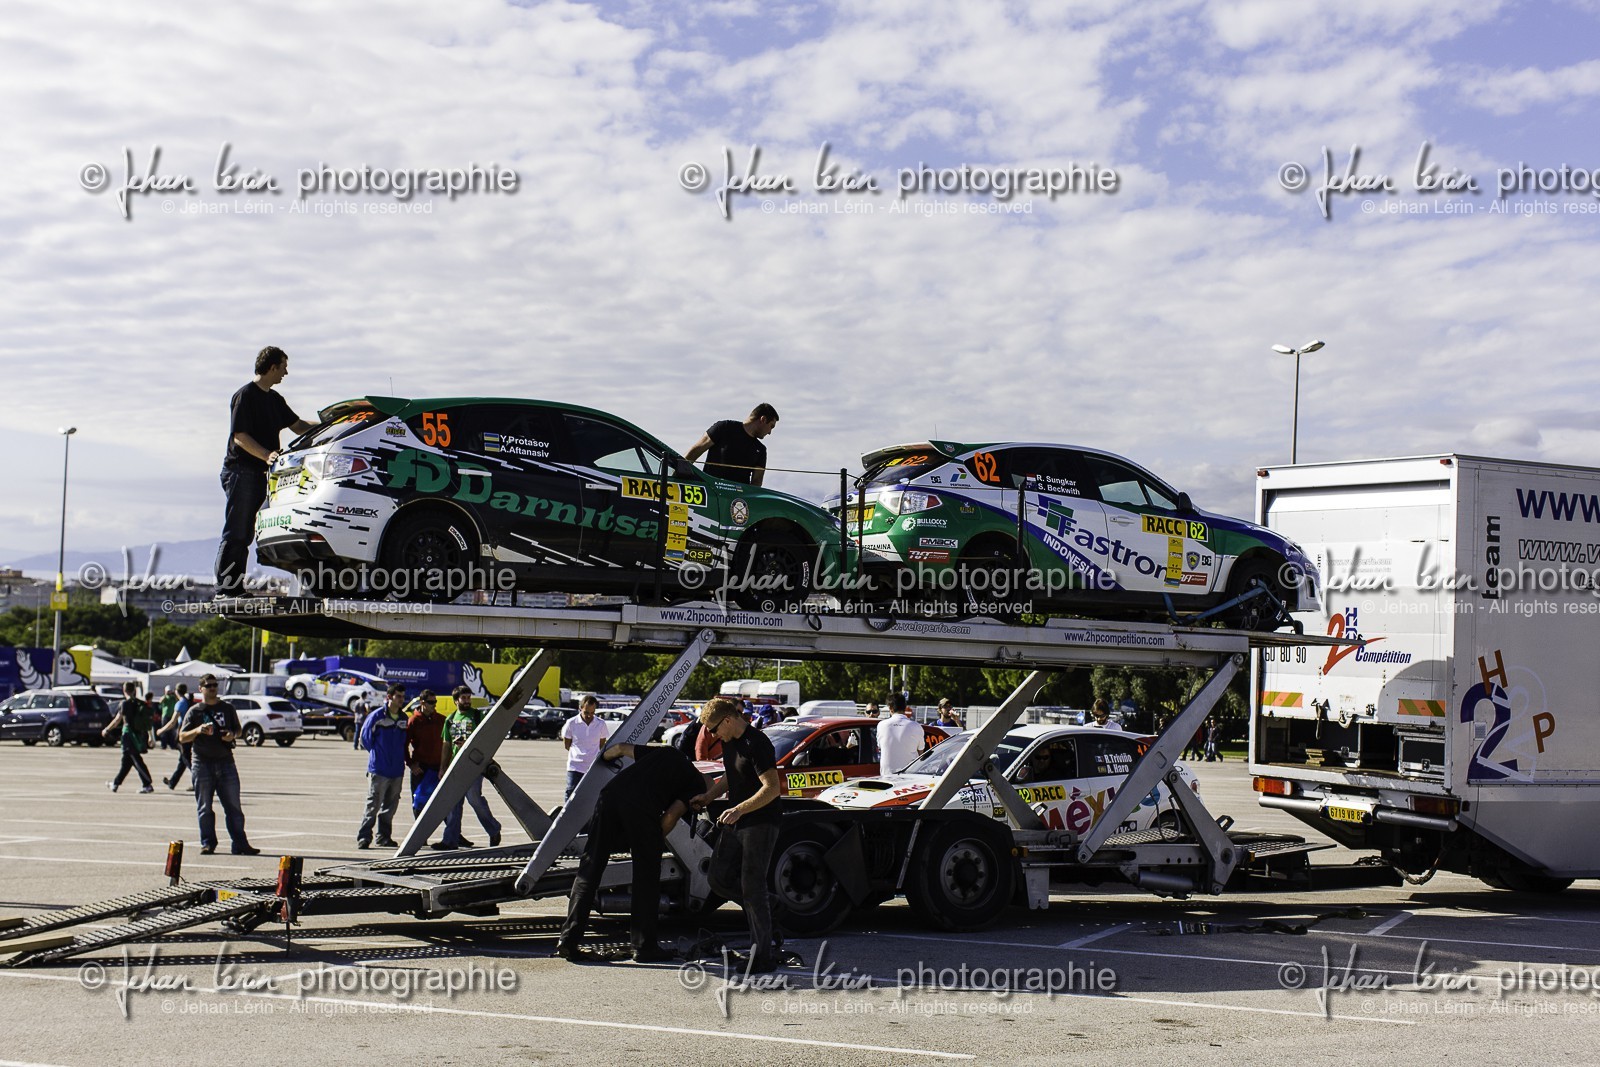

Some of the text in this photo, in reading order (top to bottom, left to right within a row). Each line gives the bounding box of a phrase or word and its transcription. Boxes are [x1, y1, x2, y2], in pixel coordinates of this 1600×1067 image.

[422, 412, 451, 448] 55
[500, 434, 550, 448] Y.Protasov
[500, 445, 550, 458] A.Aftanasiv
[900, 455, 929, 467] 62
[974, 451, 1000, 482] 62
[1036, 474, 1076, 487] R. Sungkar
[1038, 482, 1081, 495] S. Beckwith
[452, 461, 659, 541] Darnitsa
[684, 485, 703, 505] 55
[257, 511, 292, 530] Darnitsa
[1146, 518, 1205, 540] RACC 62
[689, 550, 712, 560] QSP
[1043, 532, 1096, 580] INDONESIA
[1058, 514, 1167, 581] Fastron
[1481, 515, 1500, 600] team
[660, 608, 783, 627] www.2hpcompetition.com
[1064, 631, 1165, 646] www.2hpcompetition.com
[1296, 646, 1307, 664] 90
[1355, 645, 1412, 664] Compétition
[386, 669, 427, 678] MICHELIN
[1107, 764, 1129, 774] A. Haro
[788, 772, 840, 788] 132 RACC
[1033, 786, 1063, 801] RACC
[1330, 807, 1346, 818] 6719
